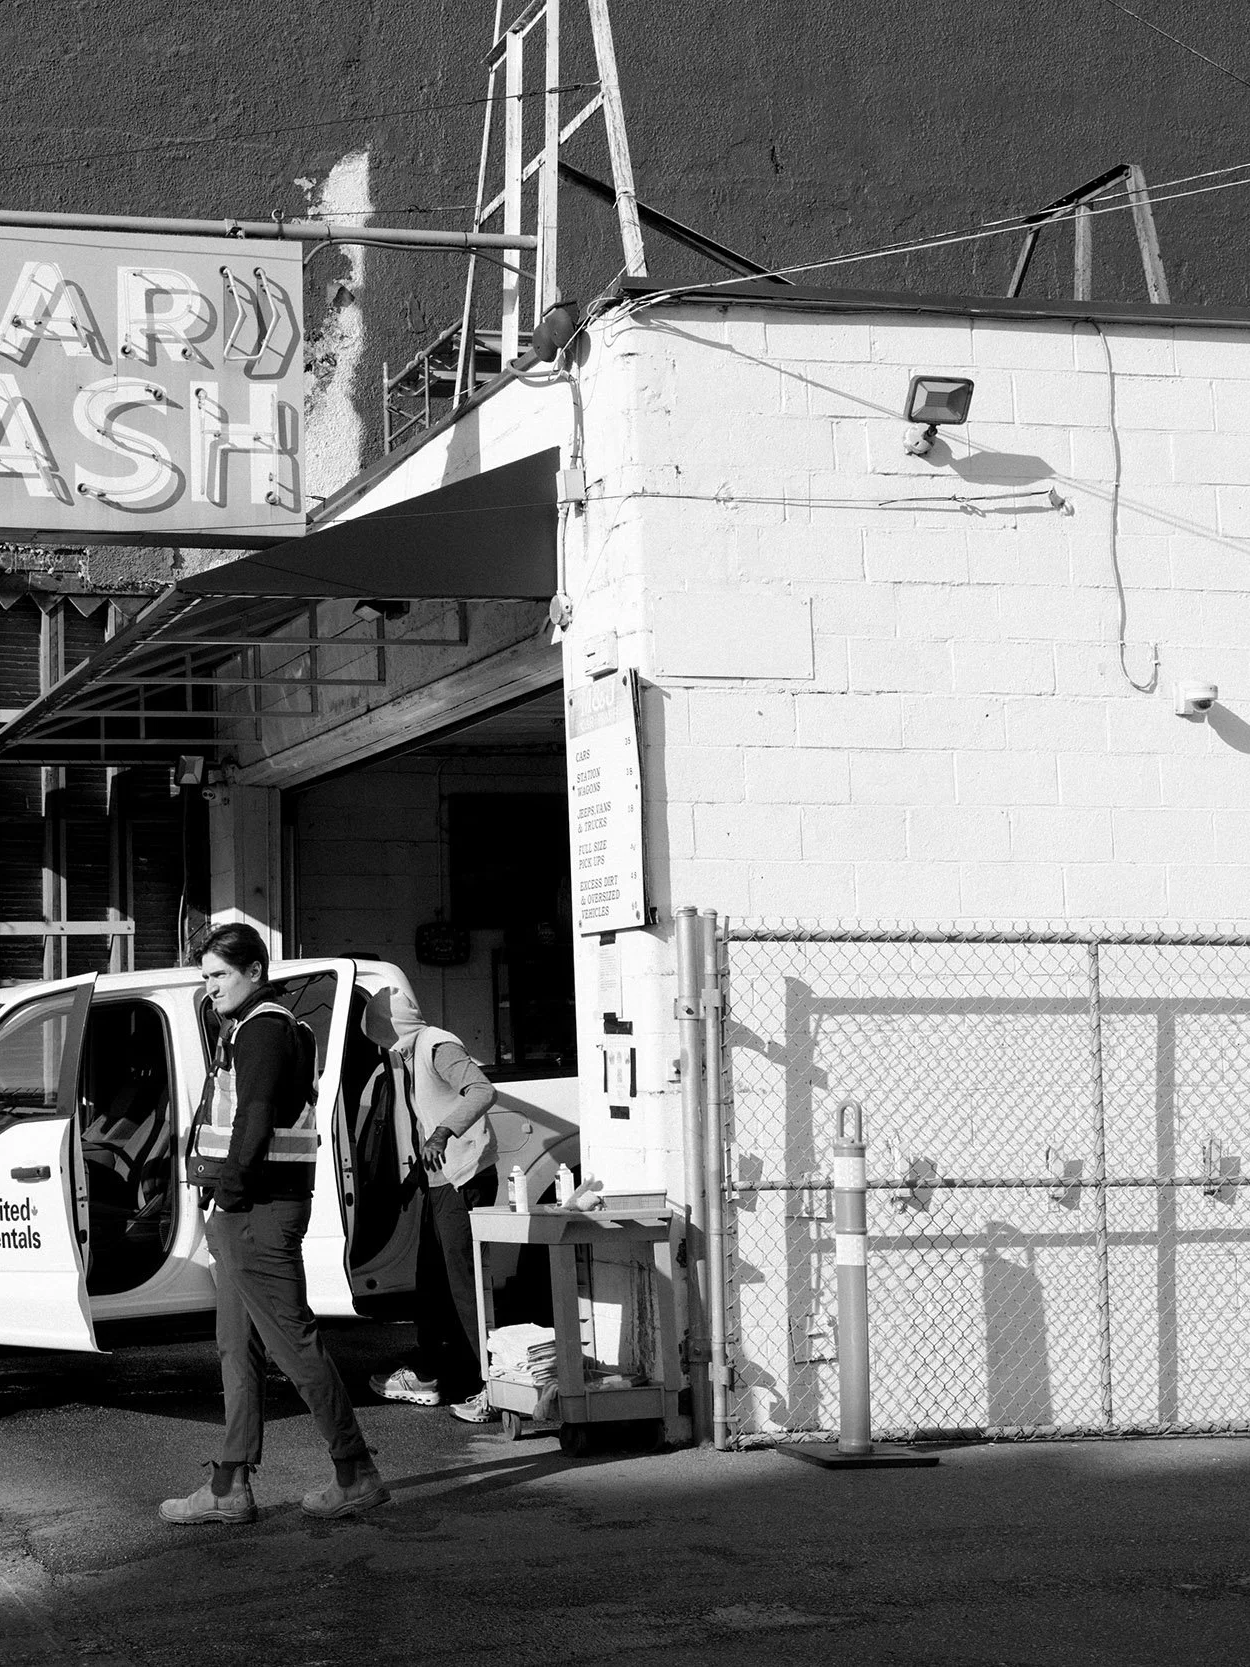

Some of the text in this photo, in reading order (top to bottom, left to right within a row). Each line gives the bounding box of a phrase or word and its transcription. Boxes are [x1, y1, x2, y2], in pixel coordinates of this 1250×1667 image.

[576, 749, 590, 762] CARS
[577, 767, 601, 783] STATION
[577, 781, 601, 797] WAGONS
[584, 817, 608, 831] TRUCKS
[579, 840, 607, 856] FULL SIZE
[579, 855, 605, 870] PICK UPS
[580, 878, 602, 892] EXCESS
[604, 875, 618, 887] DIRT
[587, 889, 620, 905] OVERSIZED
[582, 906, 609, 919] VEHICLES
